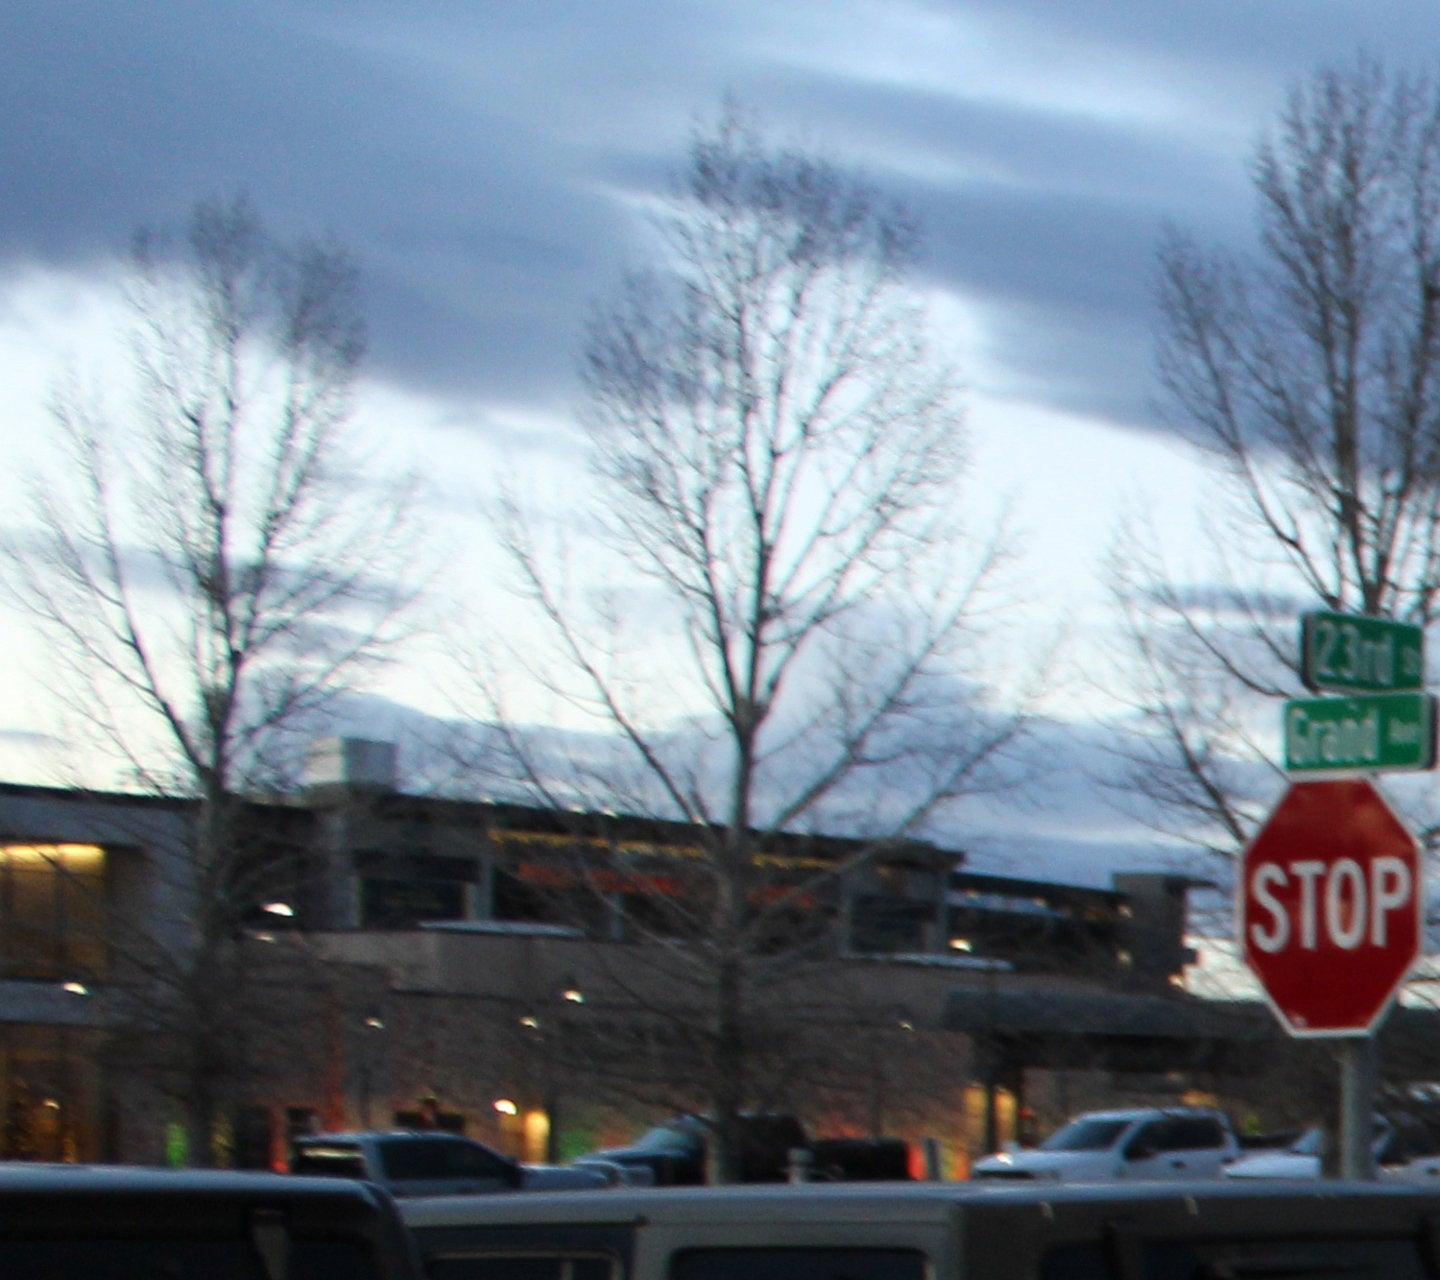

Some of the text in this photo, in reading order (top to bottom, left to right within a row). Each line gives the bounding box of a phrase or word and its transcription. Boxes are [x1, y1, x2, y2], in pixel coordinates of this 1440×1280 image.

[1313, 621, 1394, 684] 23rd
[1289, 708, 1379, 764] Grand
[1250, 856, 1412, 952] STOP
